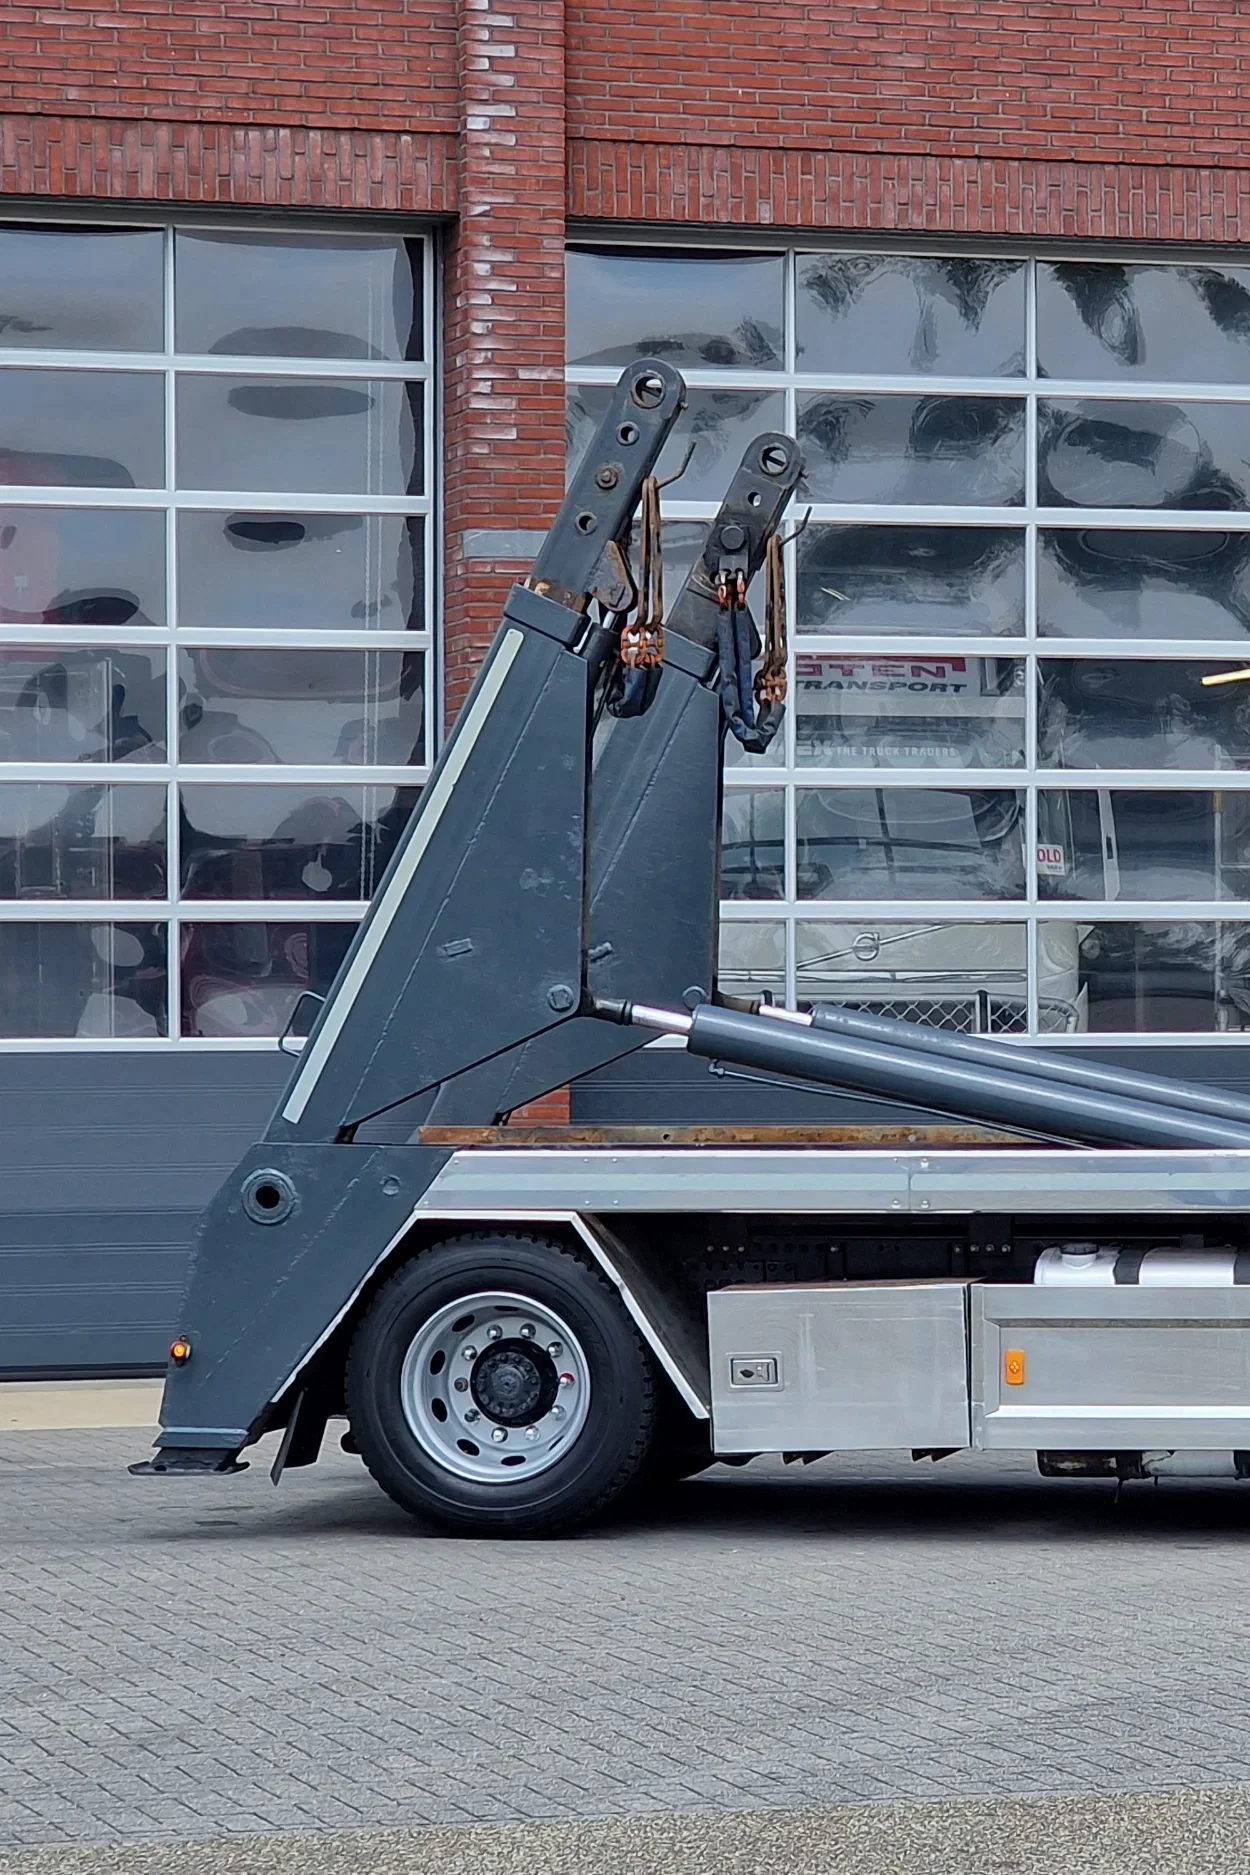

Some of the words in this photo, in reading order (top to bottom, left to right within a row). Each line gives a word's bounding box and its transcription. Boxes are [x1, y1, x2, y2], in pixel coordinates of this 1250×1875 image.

[836, 746, 857, 757] THE
[862, 746, 900, 757] TRUCK
[905, 747, 957, 758] TRADERS
